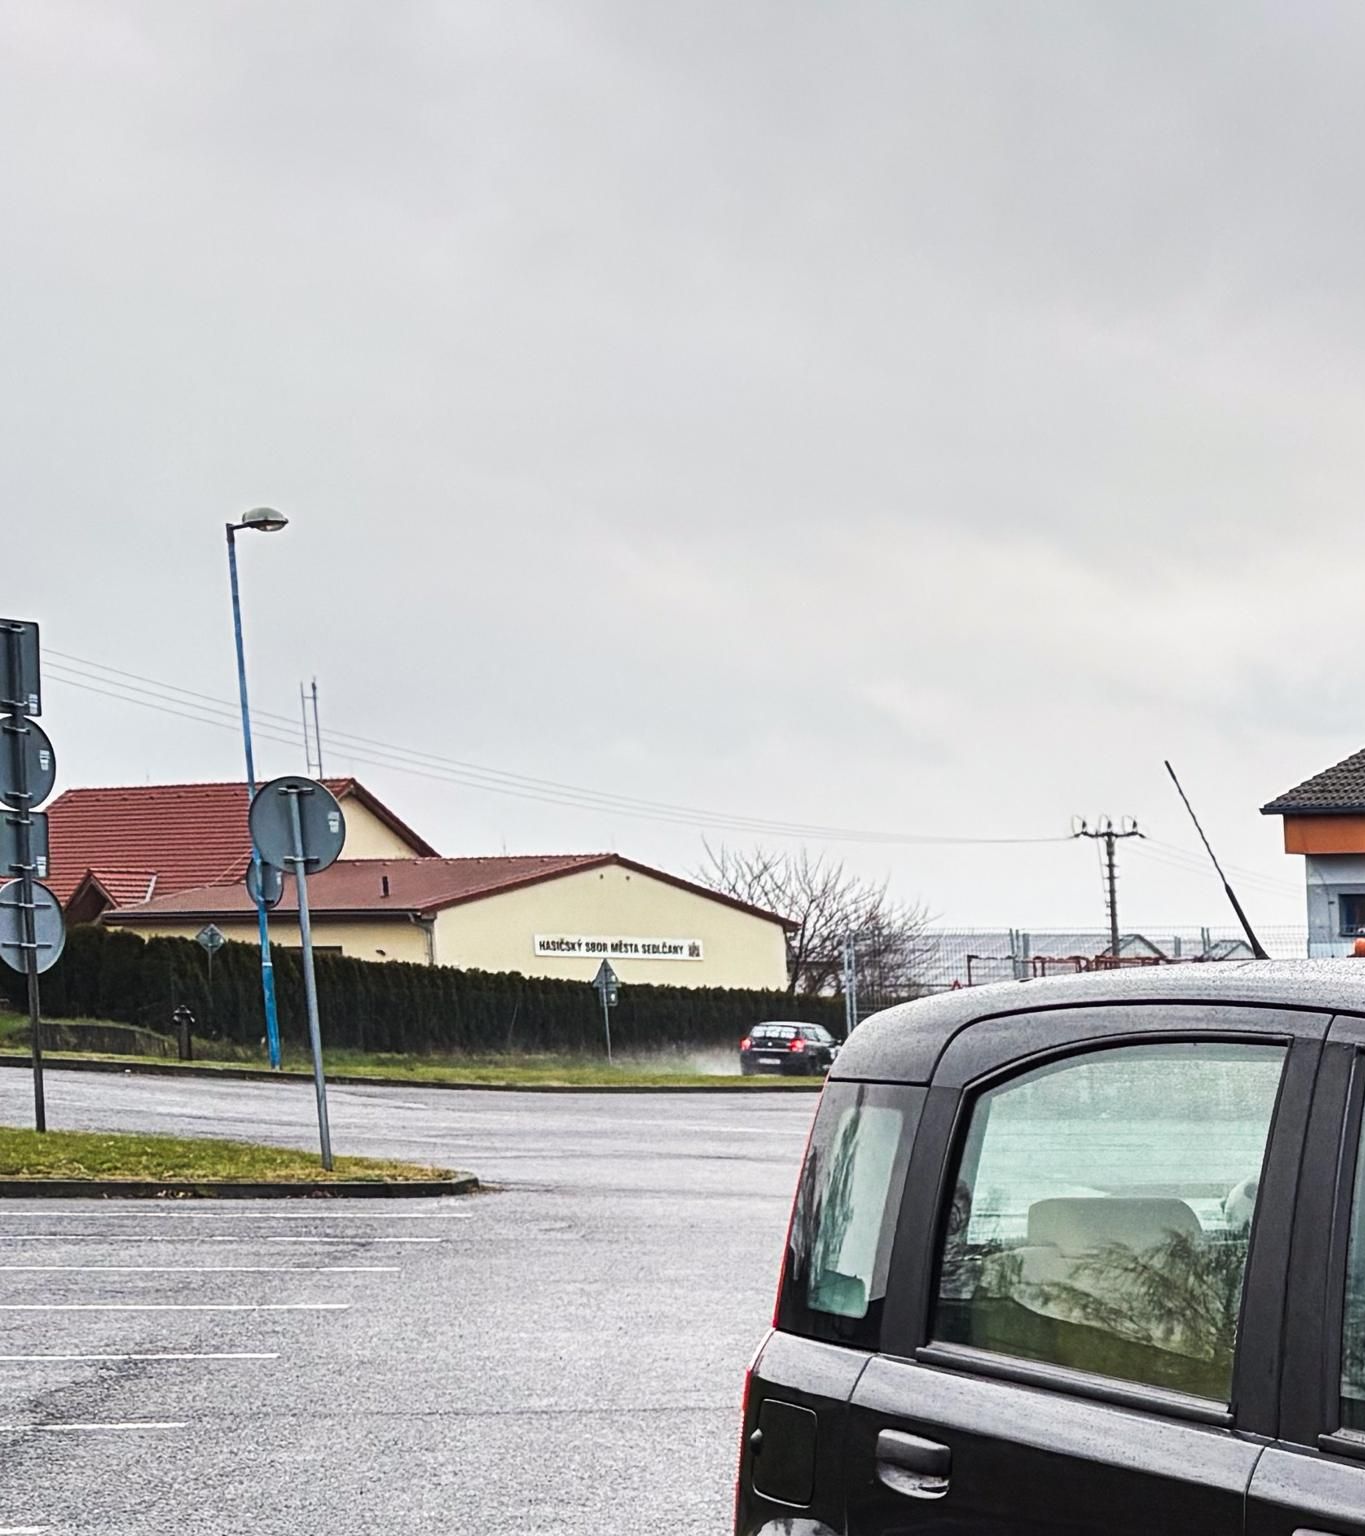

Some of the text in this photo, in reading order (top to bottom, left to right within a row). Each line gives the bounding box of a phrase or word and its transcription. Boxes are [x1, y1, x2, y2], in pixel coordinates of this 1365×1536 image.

[539, 938, 684, 955] HASIČSKÝ SBOR MĚSTA SEDLČANY
